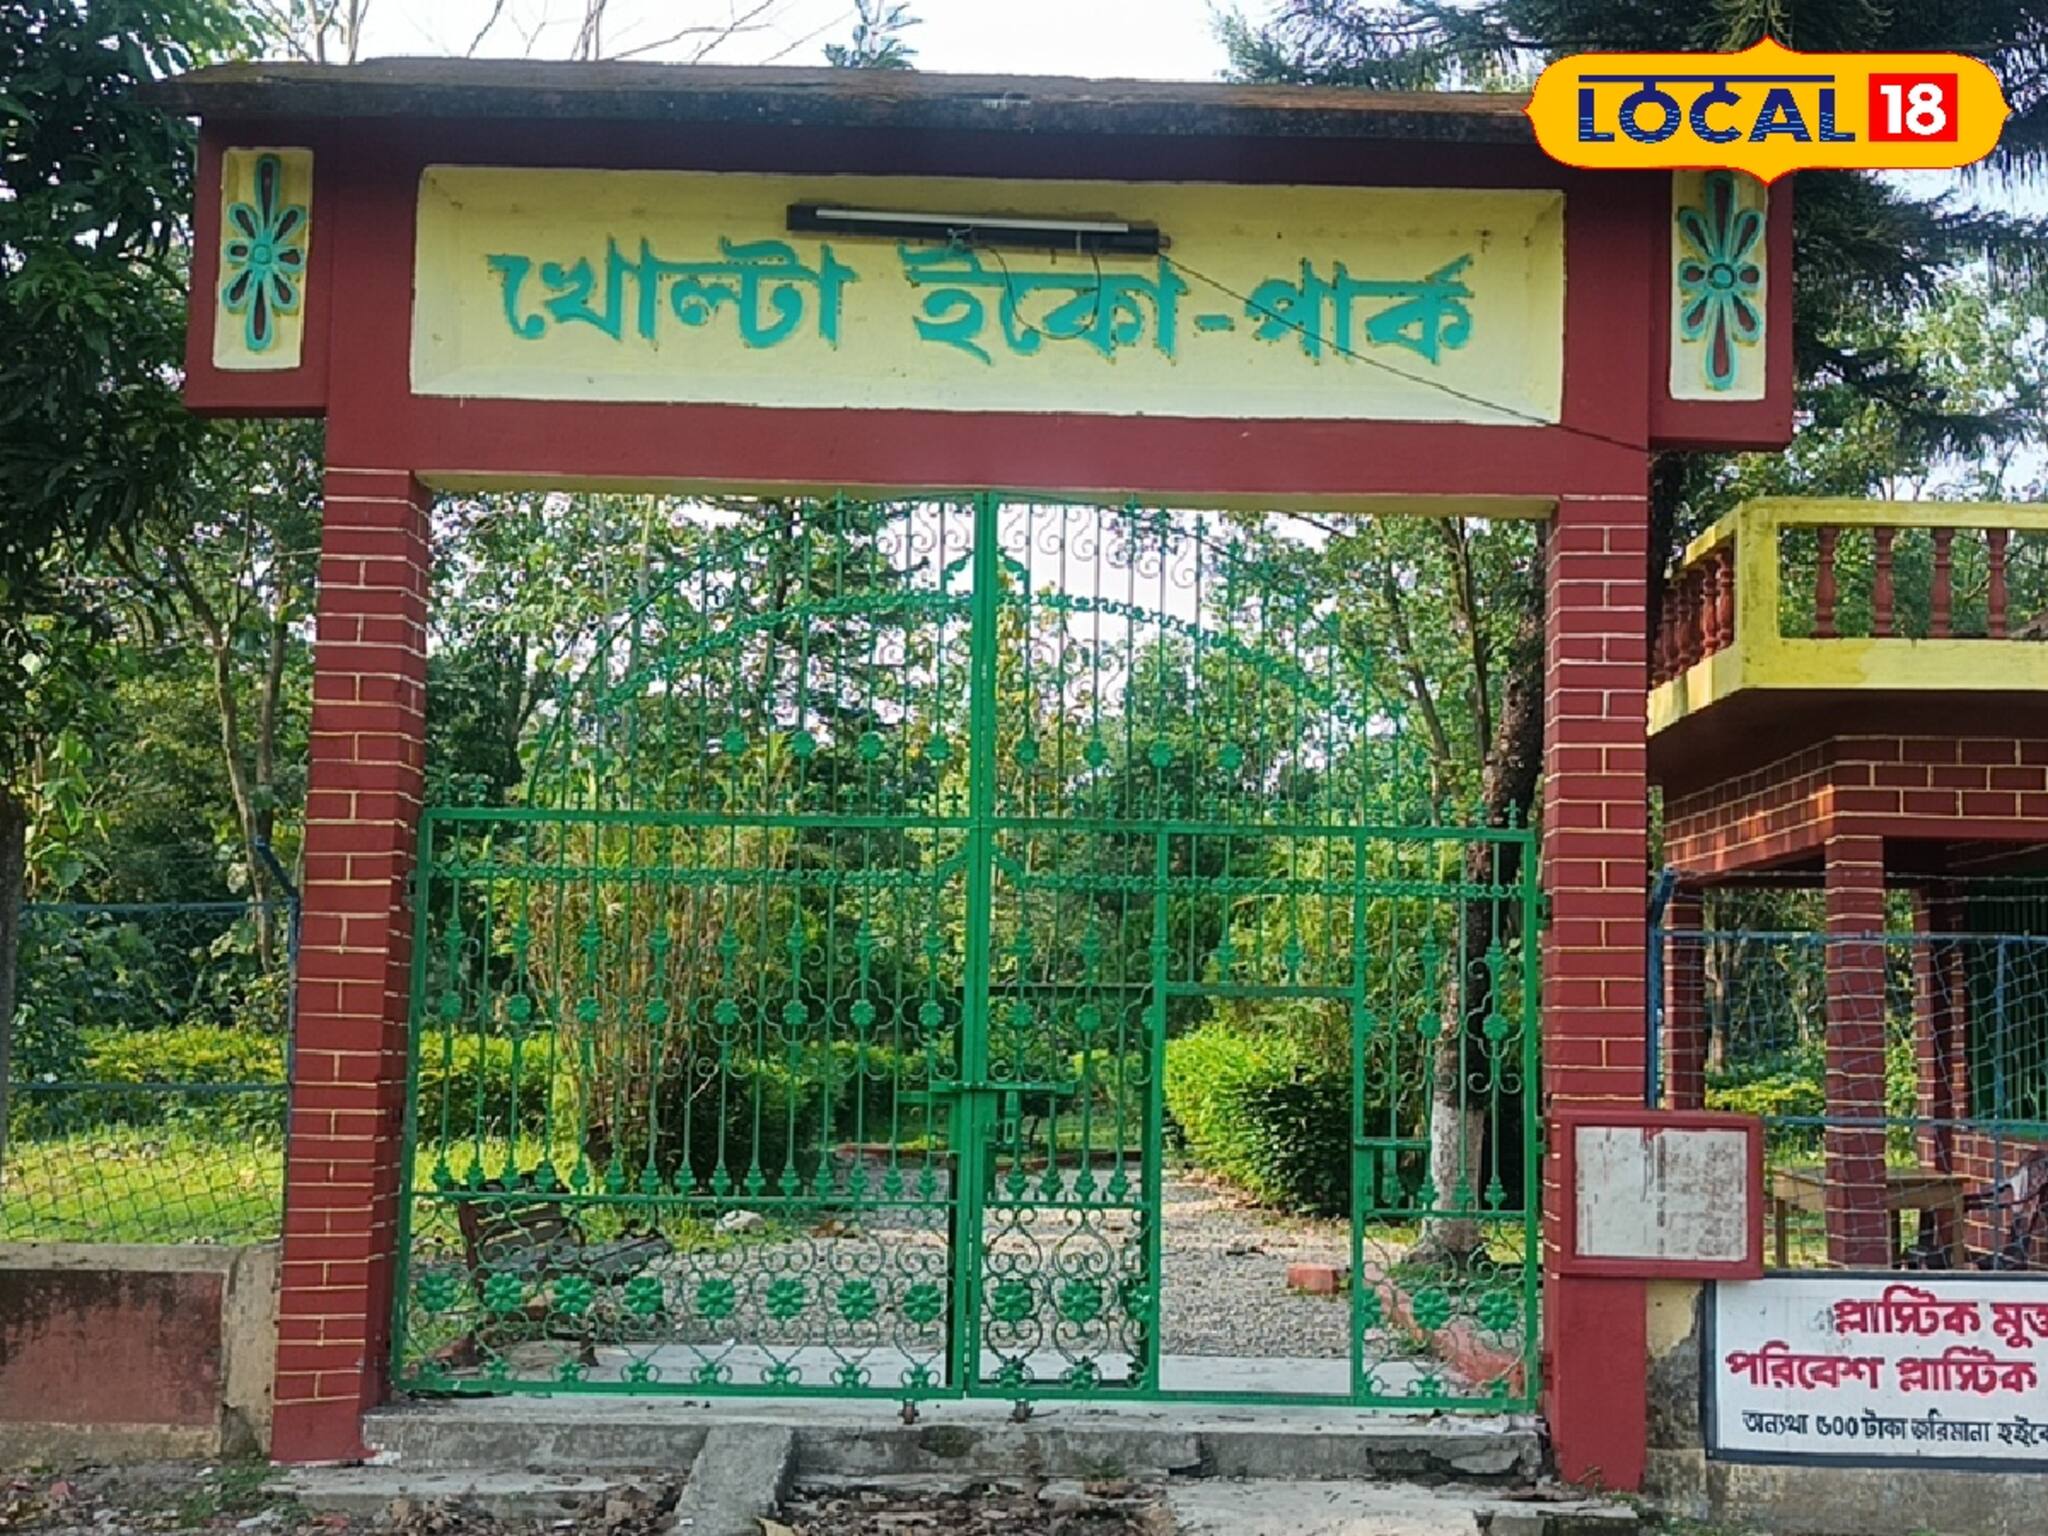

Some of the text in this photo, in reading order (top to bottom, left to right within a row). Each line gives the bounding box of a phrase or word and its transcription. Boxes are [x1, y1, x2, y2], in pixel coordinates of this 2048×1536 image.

[486, 234, 858, 351] খোল্টা
[1834, 1285, 1981, 1336] প্লাস্টিক
[1725, 1340, 2038, 1395] পরিবেশ প্লাস্টিক
[1742, 1410, 1808, 1436] অন্যথা
[1861, 1408, 1908, 1439] টাকা
[1911, 1408, 1992, 1442] জরিমানা
